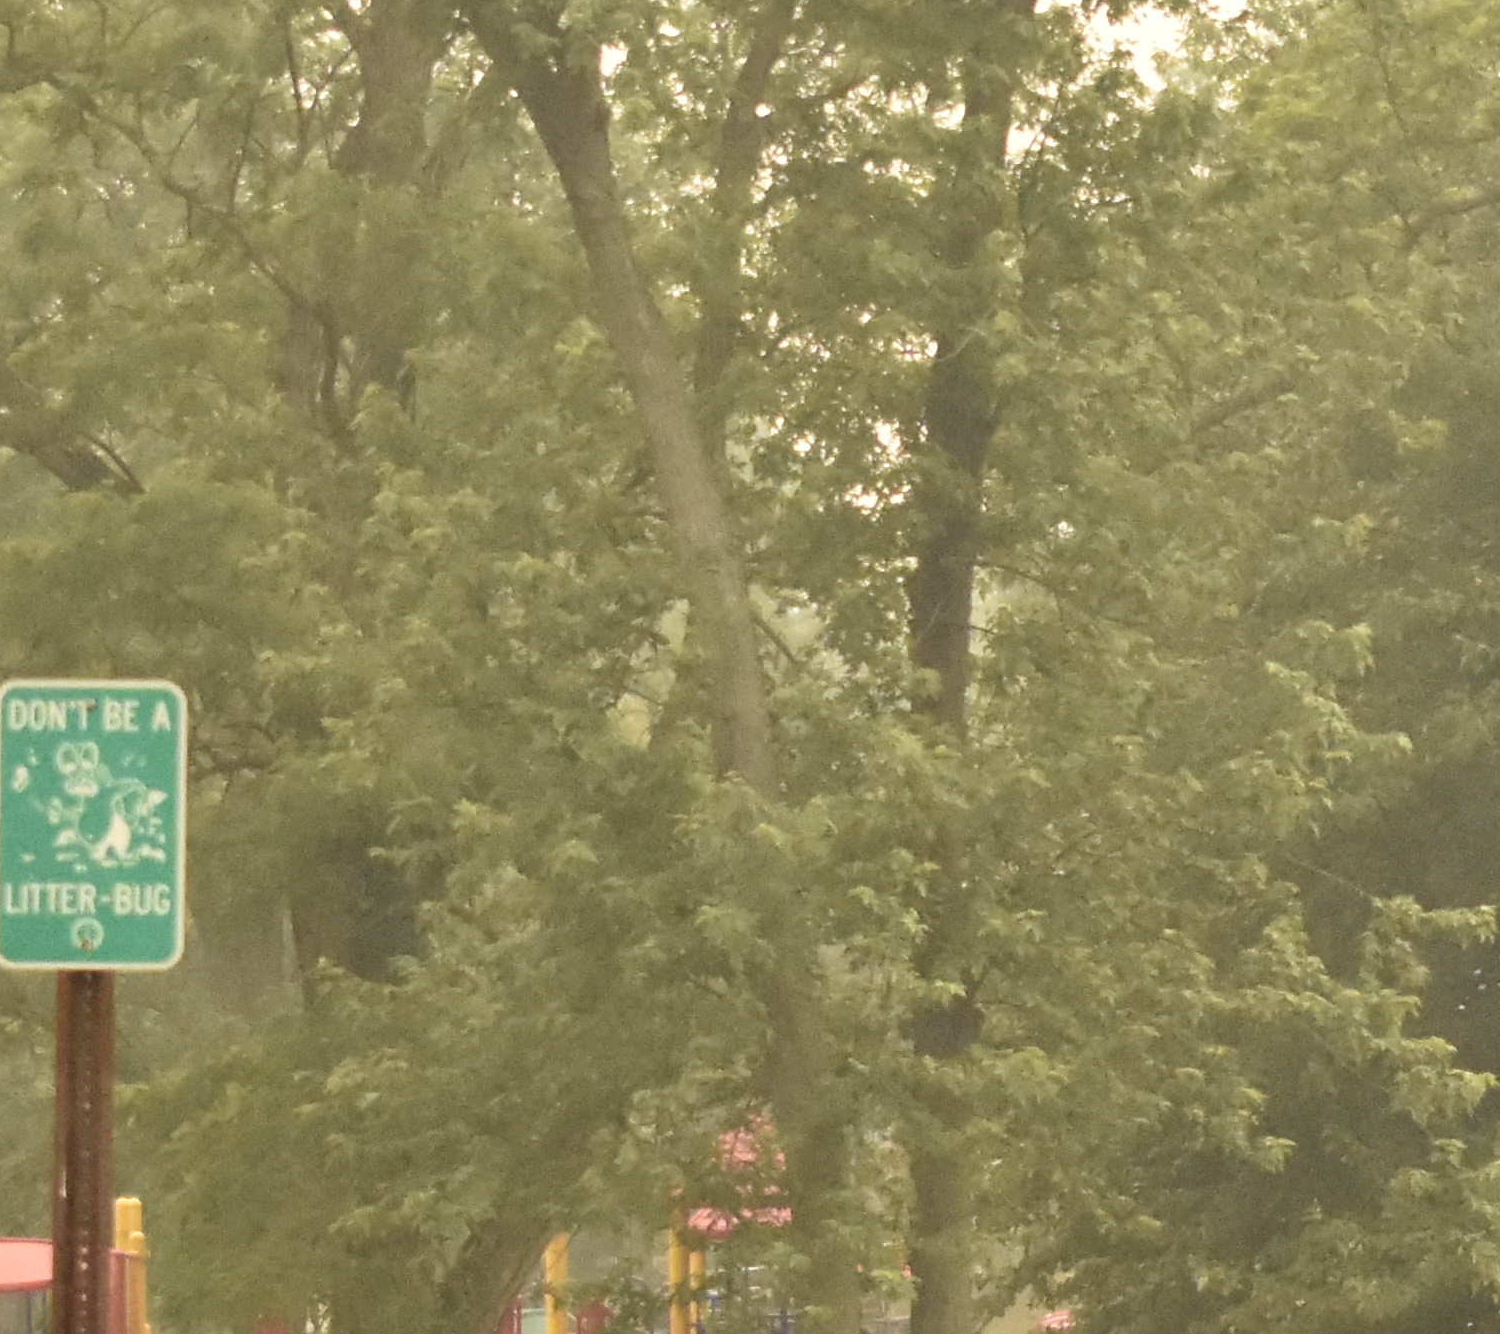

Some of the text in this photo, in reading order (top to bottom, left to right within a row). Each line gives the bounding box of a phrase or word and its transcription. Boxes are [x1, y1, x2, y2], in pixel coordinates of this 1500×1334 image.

[8, 700, 171, 732] DON'T BE A
[3, 882, 171, 916] LITTER-BUG
